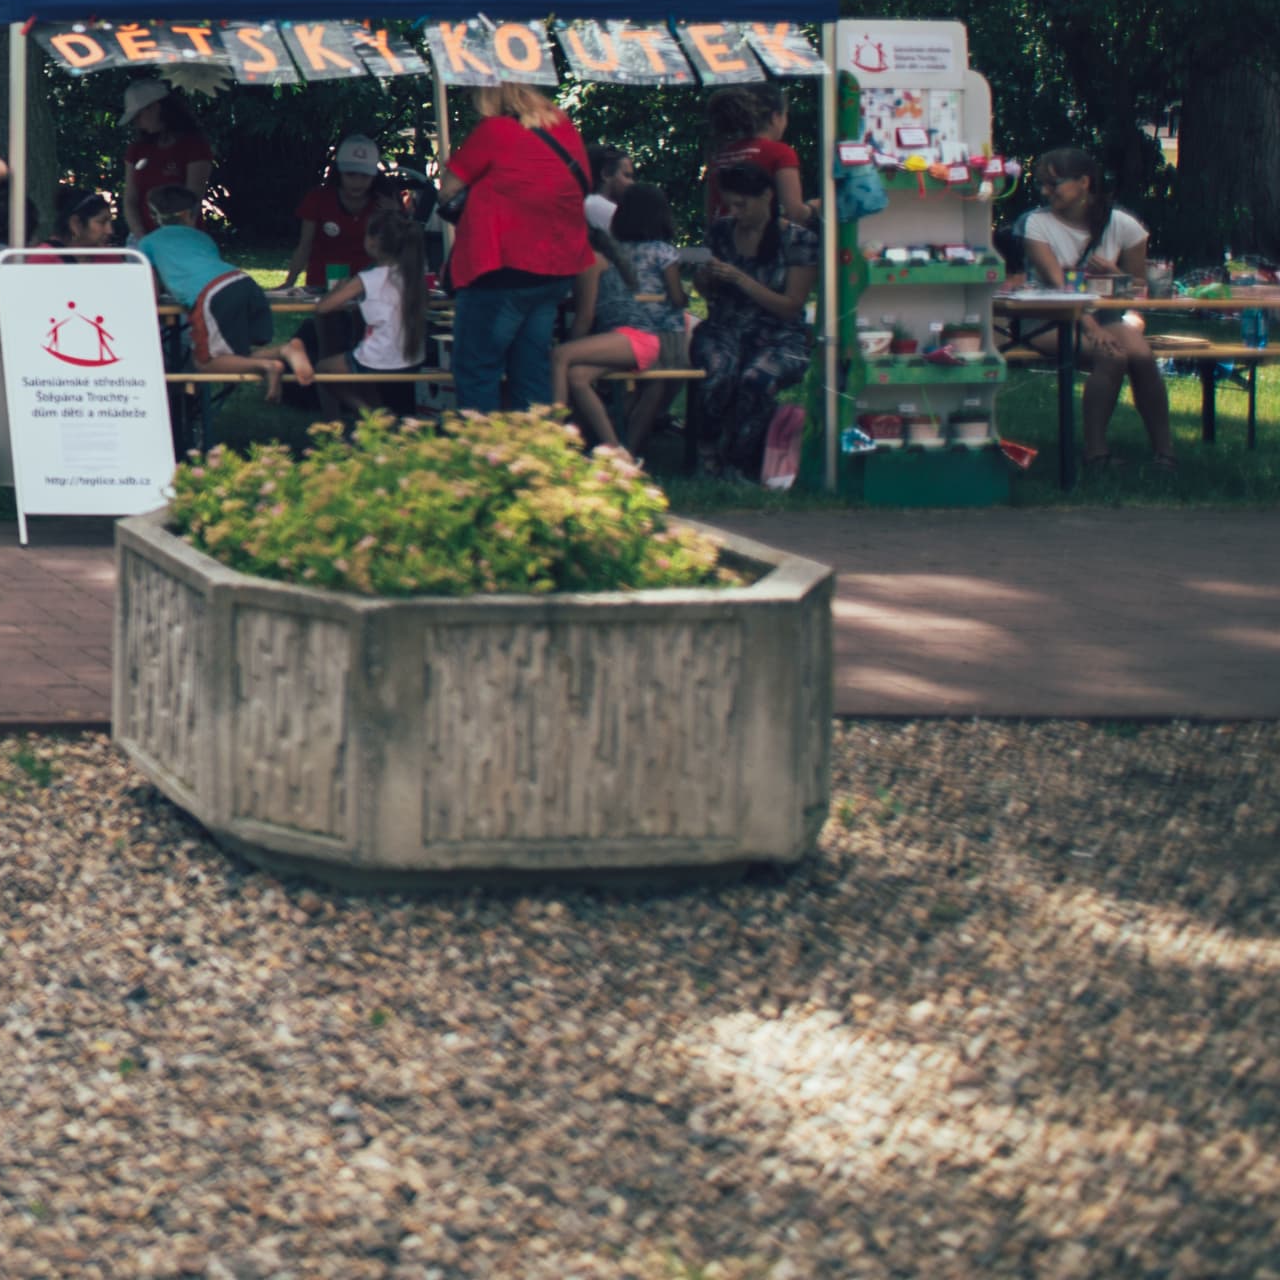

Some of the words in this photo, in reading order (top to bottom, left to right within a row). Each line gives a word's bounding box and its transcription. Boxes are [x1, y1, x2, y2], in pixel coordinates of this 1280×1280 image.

[440, 21, 815, 75] KOUTEK
[31, 407, 58, 418] dům
[98, 407, 147, 418] mládeže
